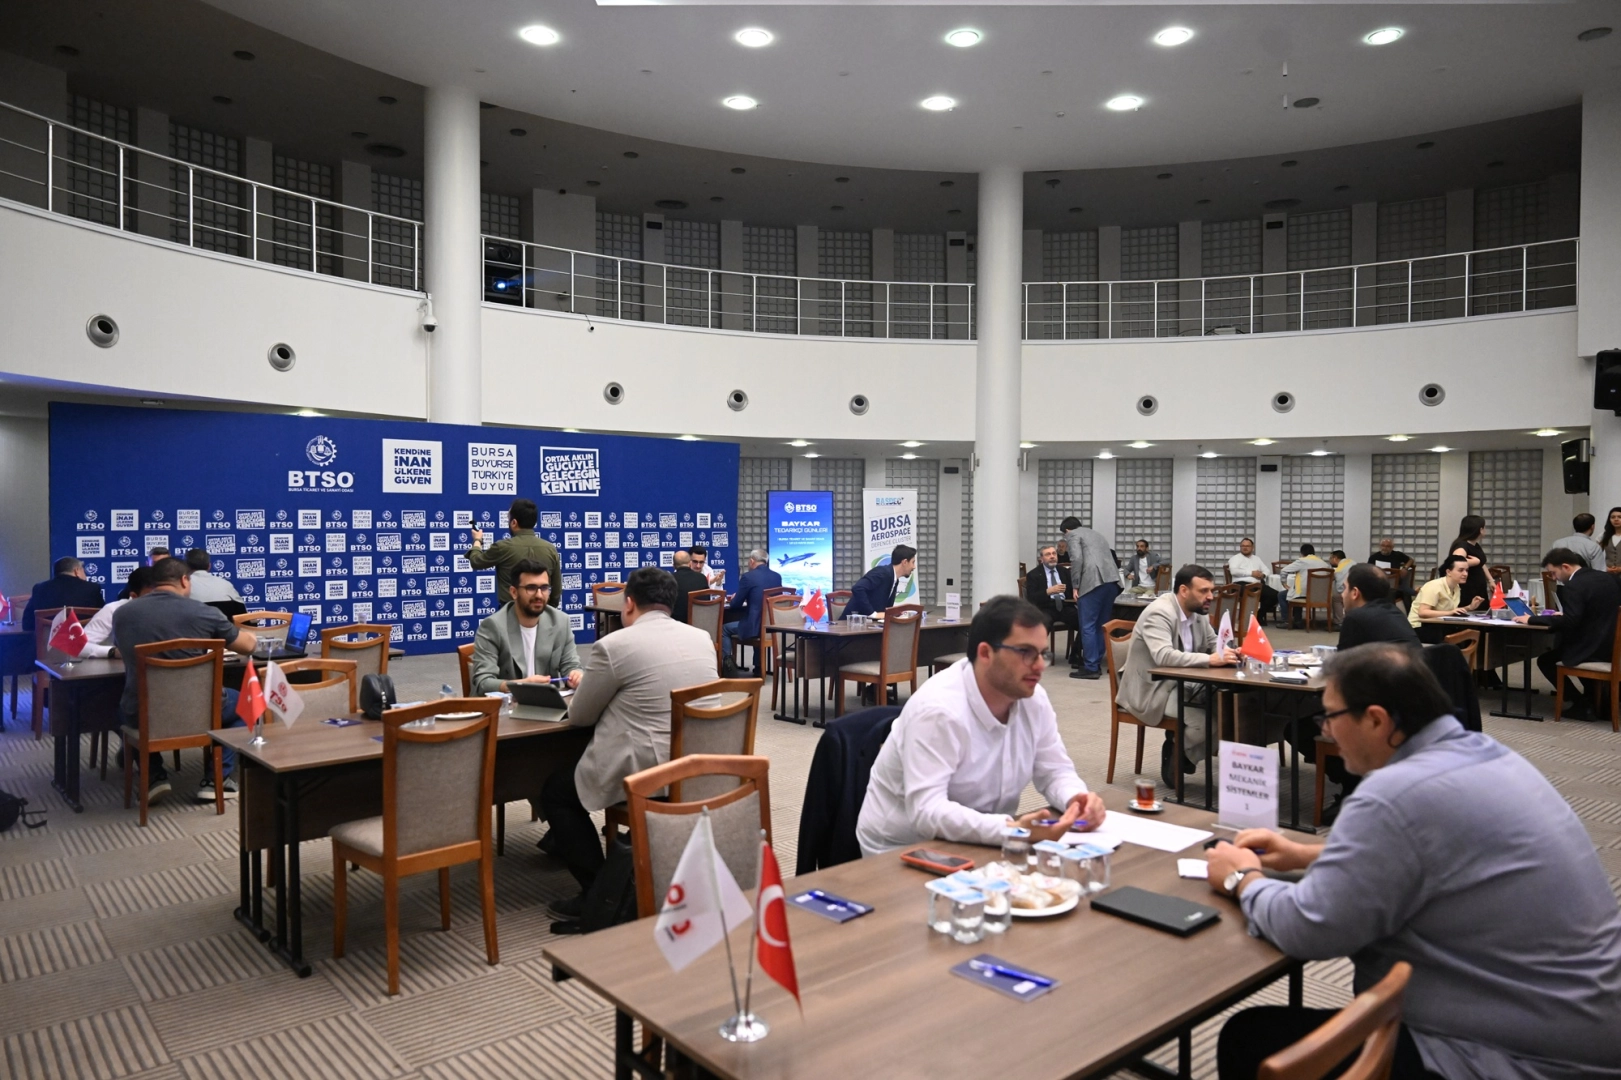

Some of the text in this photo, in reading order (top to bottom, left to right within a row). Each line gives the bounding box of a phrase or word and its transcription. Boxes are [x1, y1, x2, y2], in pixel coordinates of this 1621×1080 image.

[471, 447, 513, 457] BURSA
[471, 459, 513, 468] BÜYÜRSE
[546, 460, 594, 472] GÜCÜYLE
[288, 470, 354, 488] BTSO
[394, 476, 431, 484] GÜVEN
[472, 470, 514, 480] TÜRKİYE
[471, 482, 513, 491] BÜYÜR
[871, 514, 911, 532] BURSA
[871, 527, 911, 541] AEROSPACE
[871, 536, 911, 548] DEFENCE CLUSTER
[270, 690, 287, 713] TSO
[1232, 762, 1264, 773] BAYKAR
